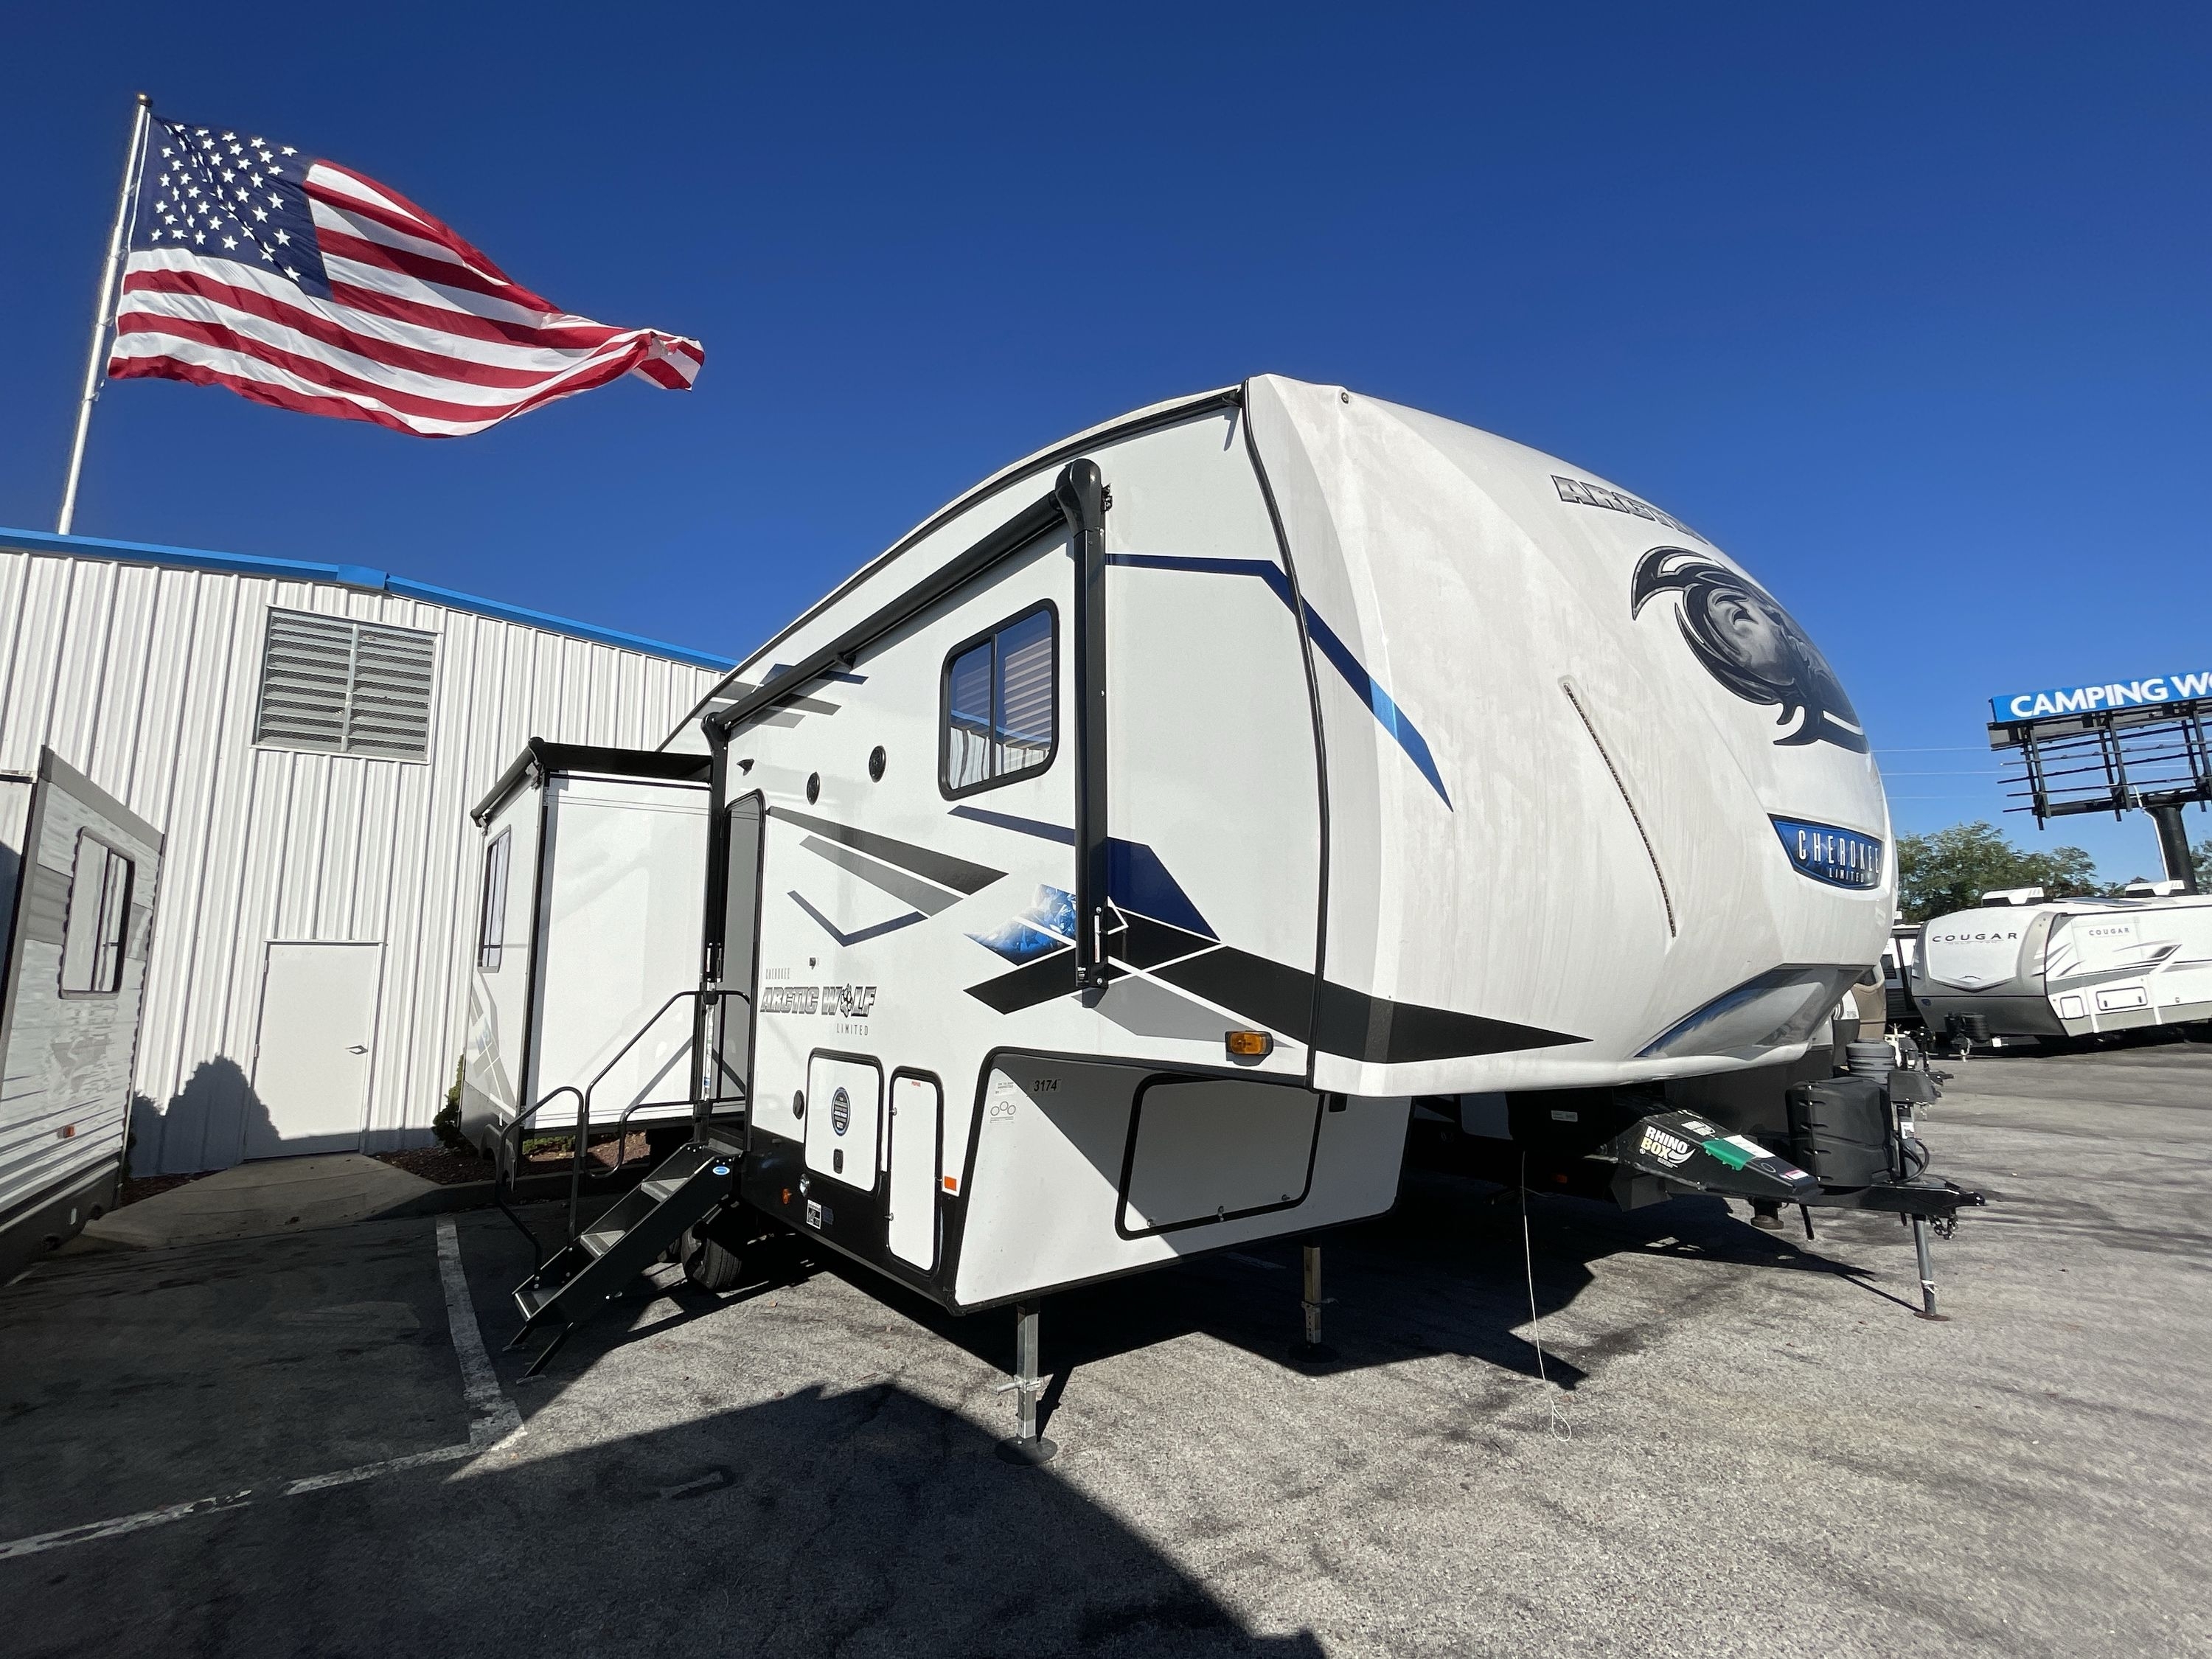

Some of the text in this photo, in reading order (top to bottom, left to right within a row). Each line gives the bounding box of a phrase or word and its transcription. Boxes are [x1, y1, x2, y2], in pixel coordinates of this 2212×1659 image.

[2010, 671, 2212, 718] CAMPING W
[1798, 830, 1879, 874] CHEROKEE
[1829, 867, 1864, 883] LIMITED
[1932, 932, 2017, 942] COUGAR
[2088, 928, 2130, 936] COUGAR
[759, 986, 820, 1015] ARCTIC
[836, 1023, 869, 1036] LIMITED
[1033, 1079, 1057, 1092] 3174
[1640, 1136, 1672, 1161] BOX
[1644, 1125, 1688, 1155] RHINO
